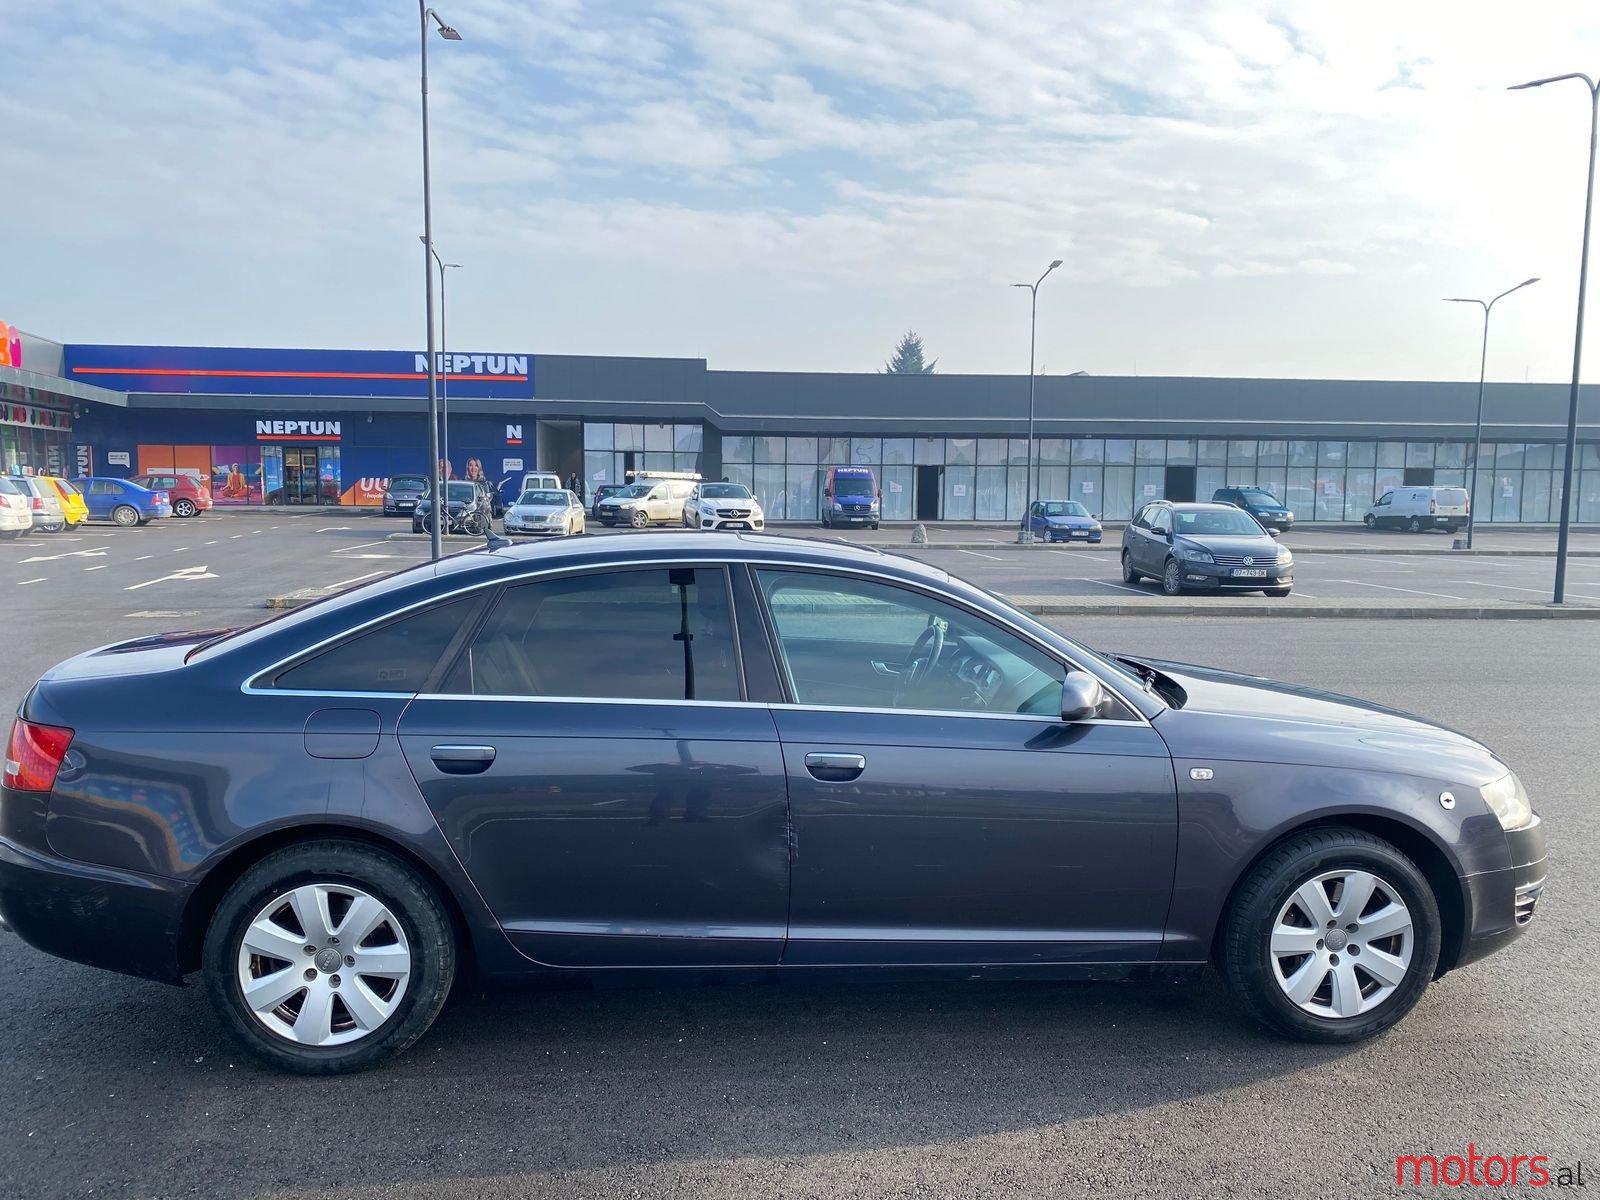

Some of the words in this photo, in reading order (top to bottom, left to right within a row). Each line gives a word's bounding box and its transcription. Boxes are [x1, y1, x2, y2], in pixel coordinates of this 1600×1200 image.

[415, 354, 528, 374] NEPTUN
[256, 420, 341, 435] NEPTUN
[506, 424, 522, 439] N
